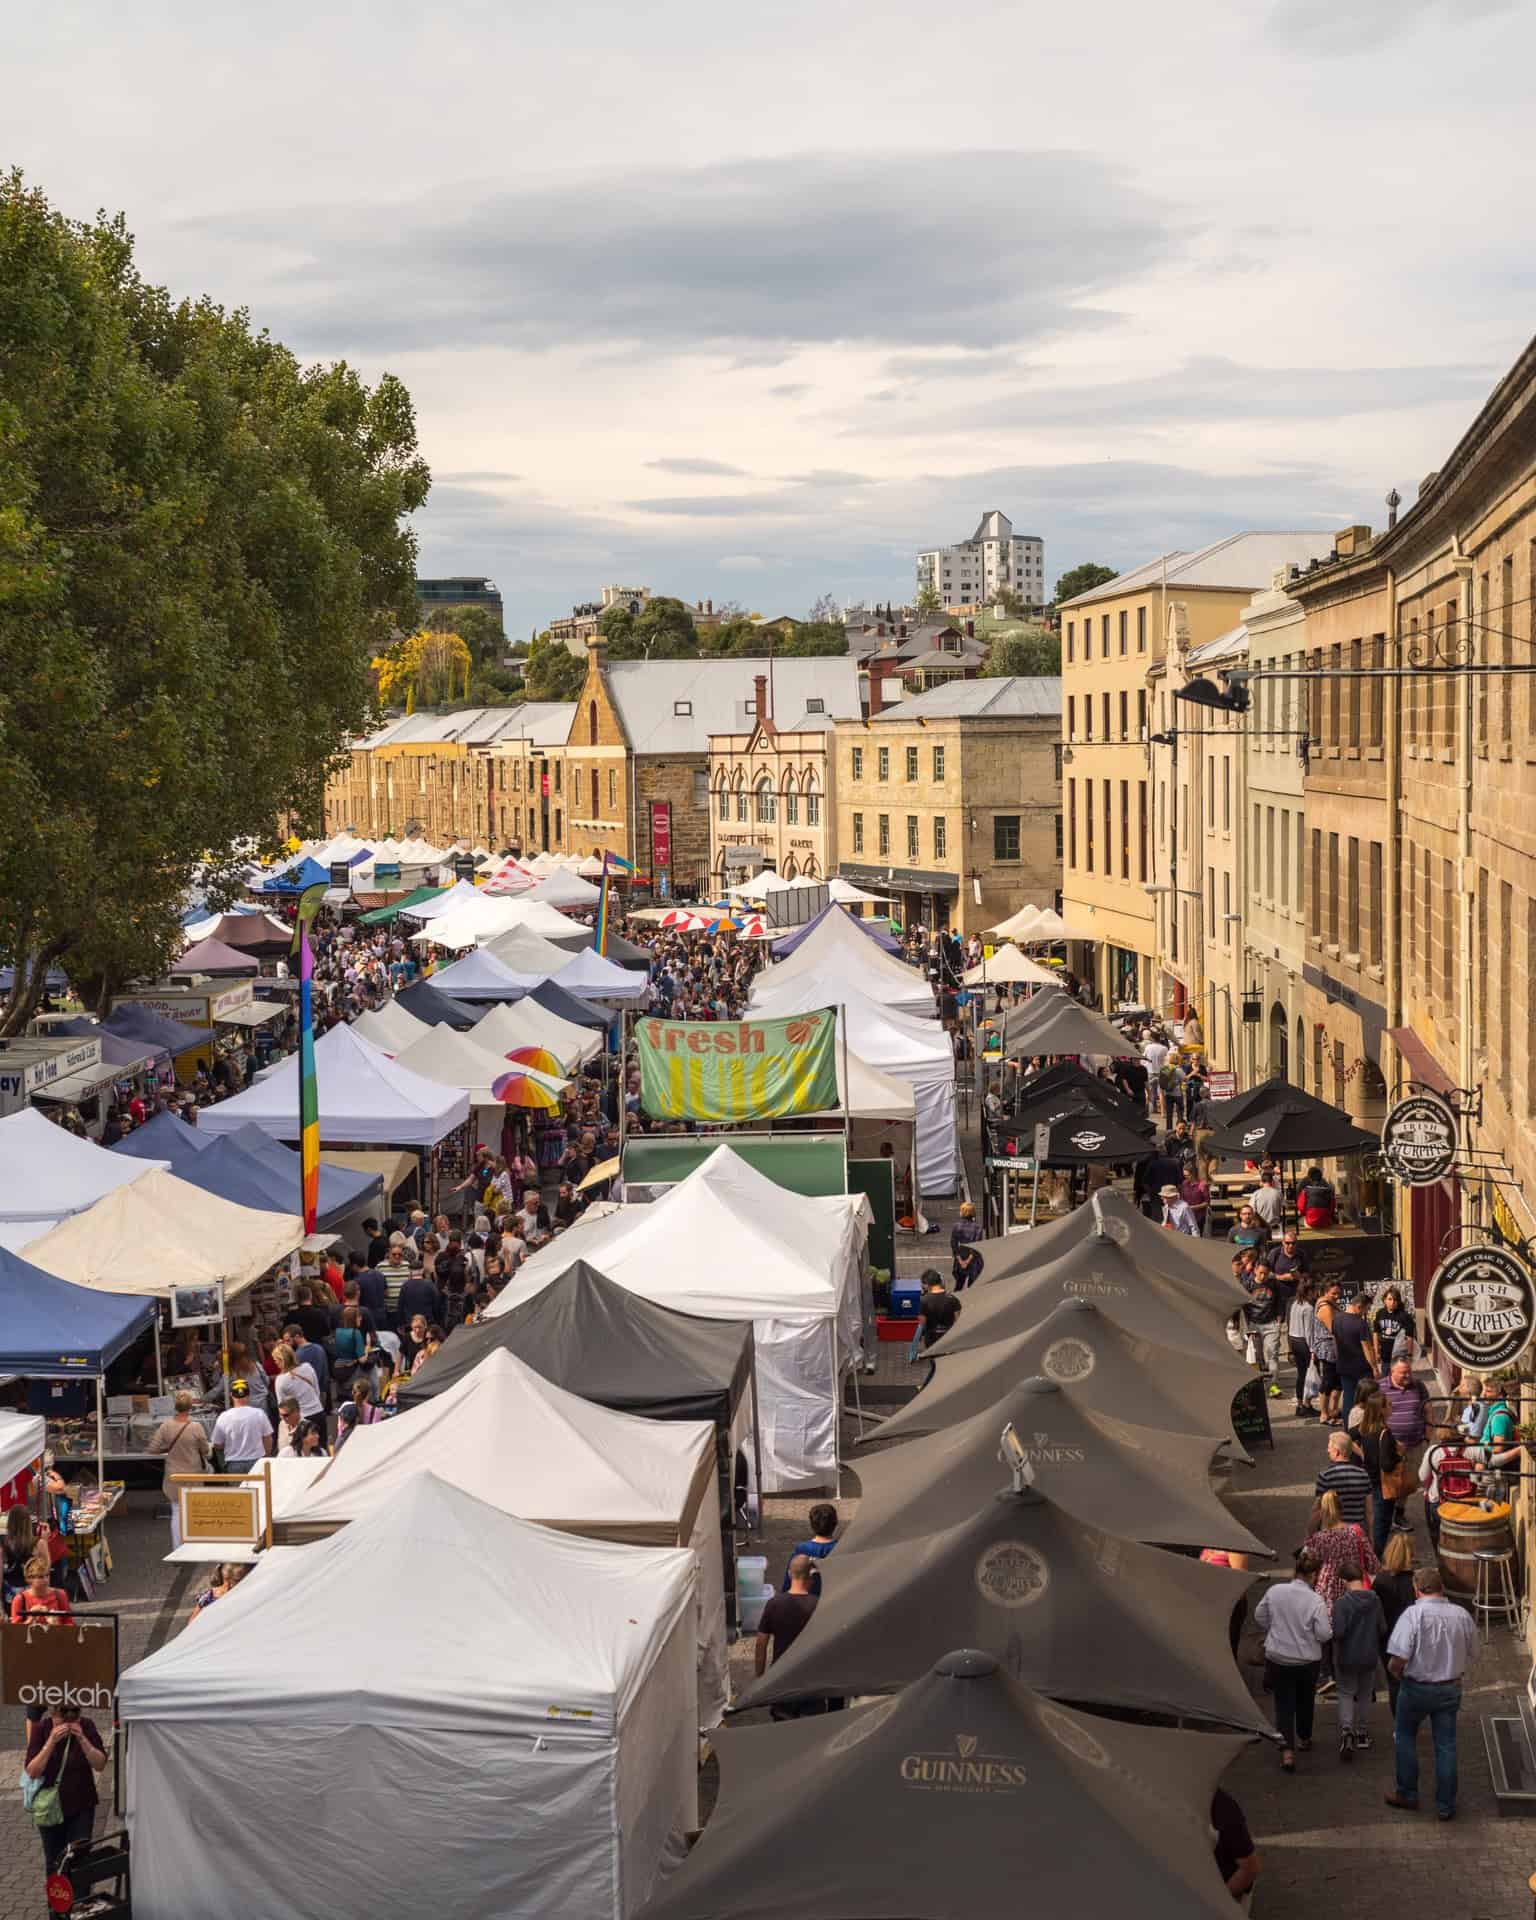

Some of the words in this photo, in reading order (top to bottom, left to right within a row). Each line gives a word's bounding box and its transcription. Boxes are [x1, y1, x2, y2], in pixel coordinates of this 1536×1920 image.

[647, 1020, 764, 1053] fresh
[660, 1047, 826, 1120] JUICE
[1403, 1124, 1437, 1132] IRISH
[993, 1159, 1029, 1169] VOUCHERS
[1063, 1280, 1129, 1297] GUINNESS
[1460, 1284, 1507, 1295] IRISH
[1443, 1307, 1524, 1334] MURPHYS
[997, 1447, 1085, 1462] INNESS
[18, 1680, 112, 1708] otekah
[900, 1756, 1026, 1784] GUINNESS
